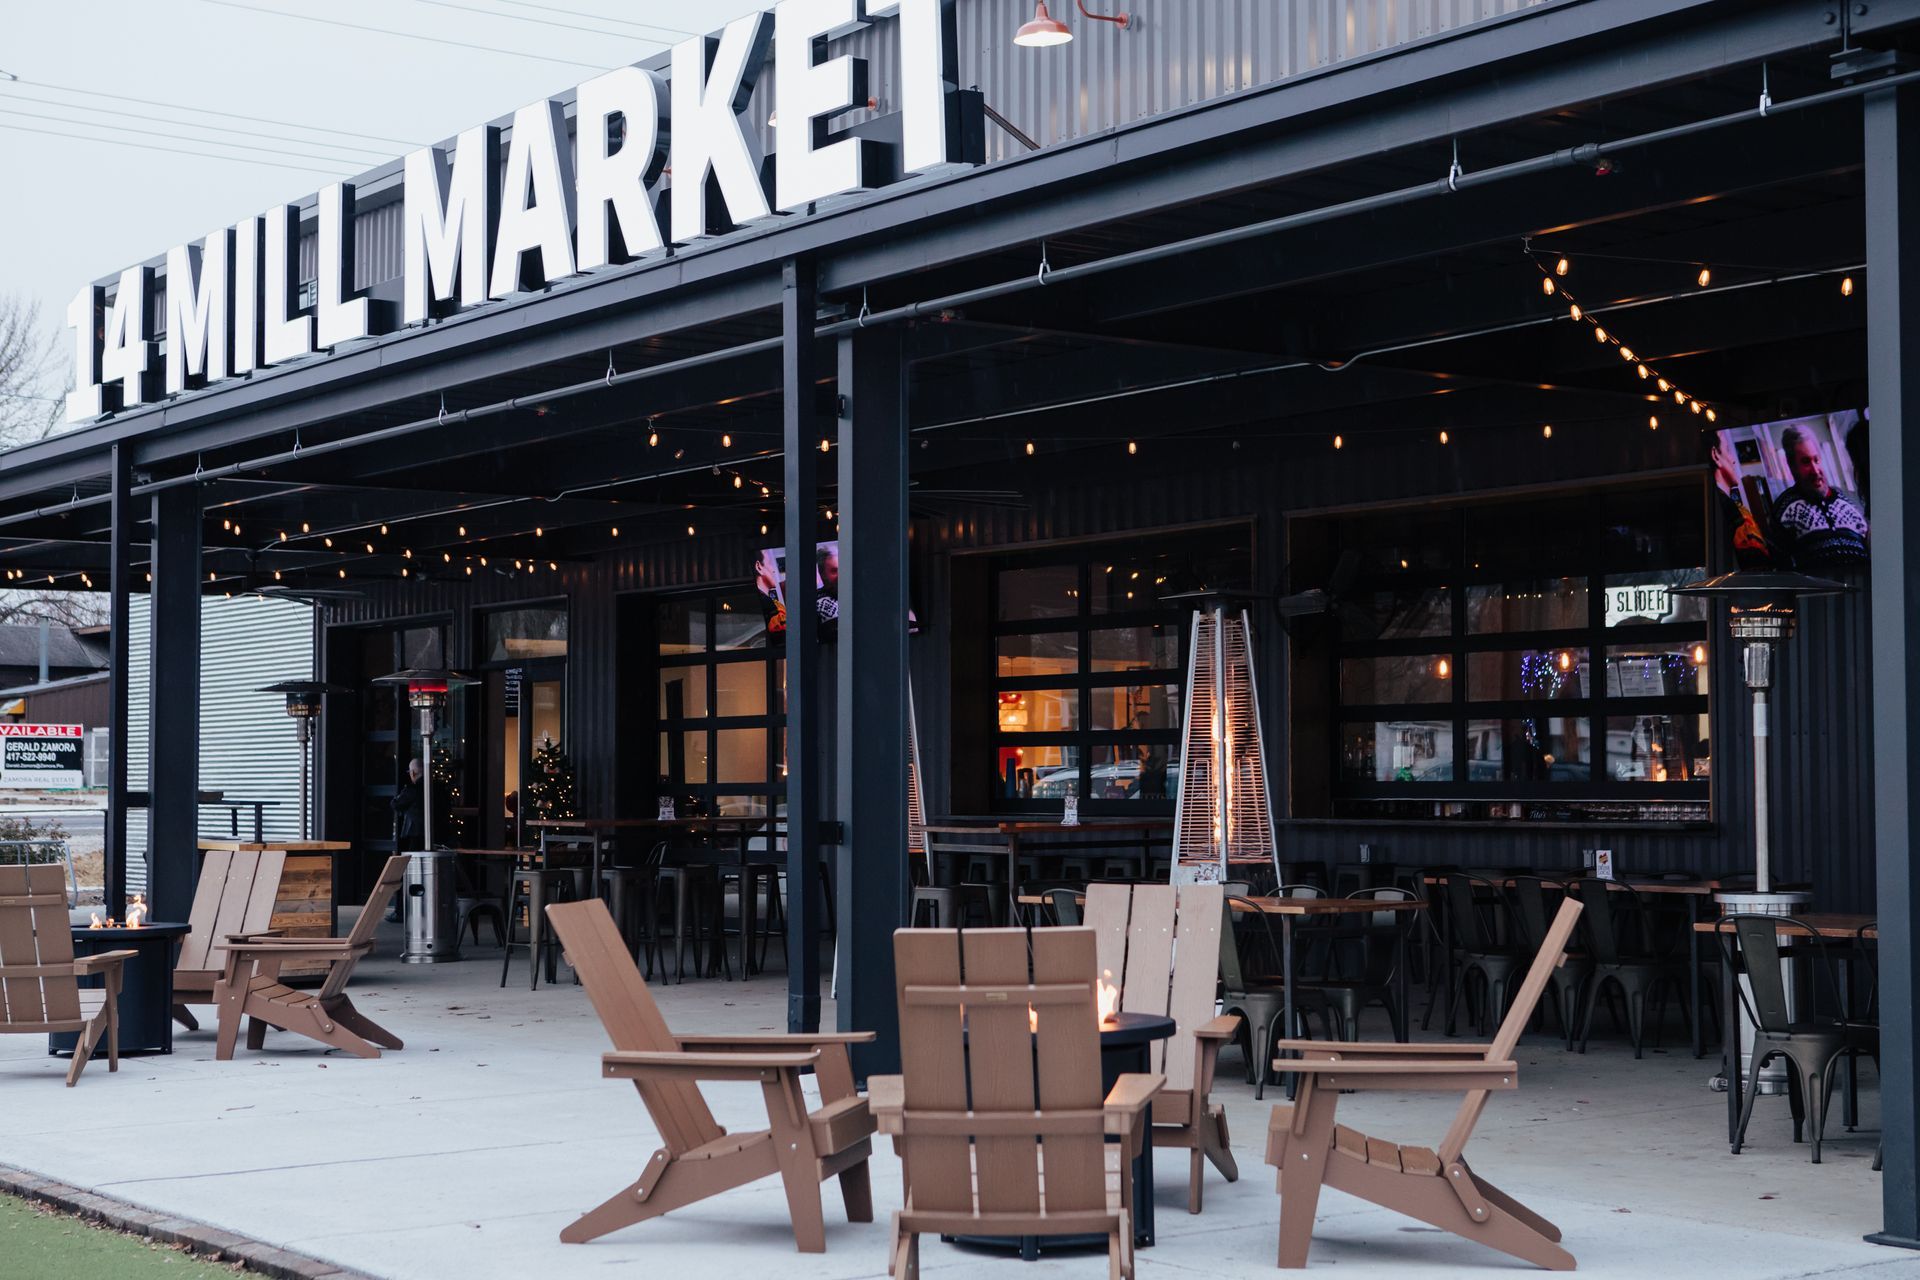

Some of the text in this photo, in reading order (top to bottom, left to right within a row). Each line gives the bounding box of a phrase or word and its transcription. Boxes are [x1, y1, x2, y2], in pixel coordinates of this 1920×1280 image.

[65, 0, 945, 423] 14 MILL MARKET
[1617, 590, 1665, 612] SLIDER
[6, 742, 76, 752] GERALD ZAMORA
